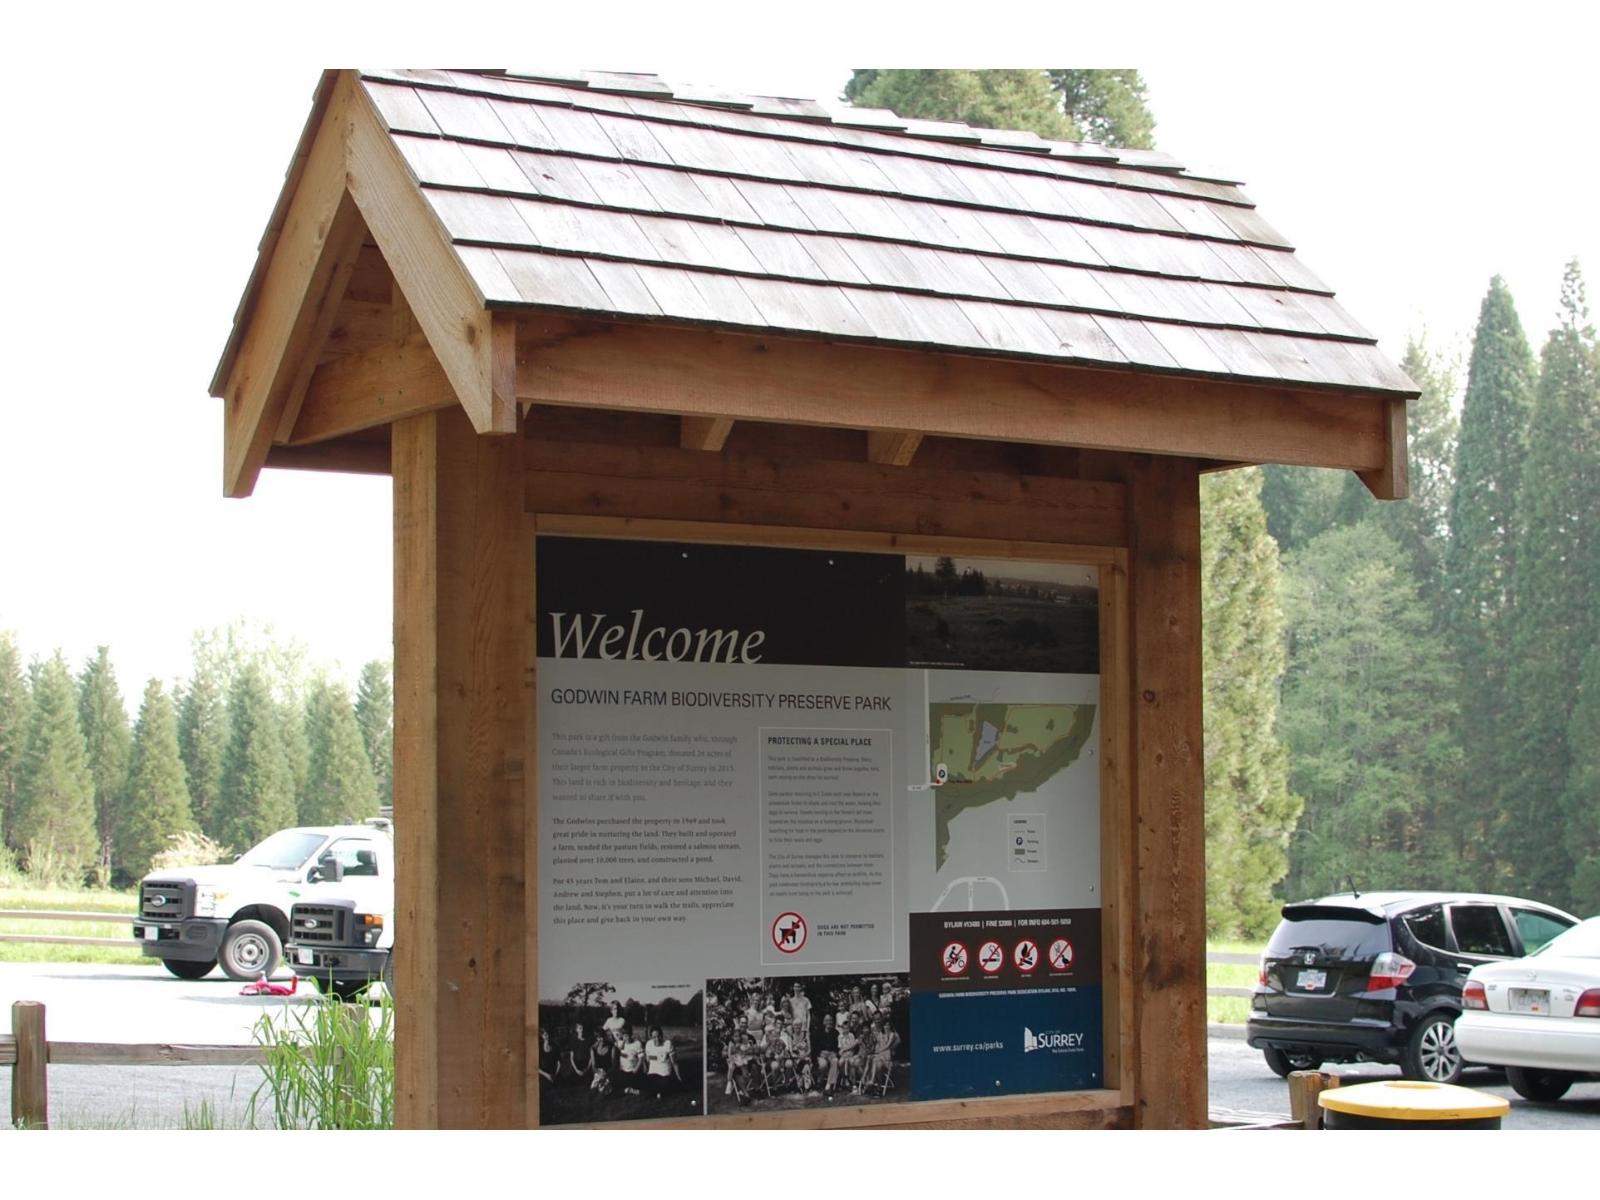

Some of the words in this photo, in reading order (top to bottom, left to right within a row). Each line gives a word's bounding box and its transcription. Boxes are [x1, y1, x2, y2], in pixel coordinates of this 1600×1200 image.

[549, 609, 765, 664] Welcome
[551, 688, 619, 705] GODWIN
[623, 690, 667, 706] FARM
[671, 691, 775, 708] BIODIVERSITY
[778, 694, 852, 710] PRESERVE
[855, 696, 891, 711] PARK
[768, 737, 811, 745] PROTECTING
[820, 738, 850, 746] SPECIAL
[850, 738, 873, 747] PLACE
[1018, 919, 1028, 927] FOR
[933, 1040, 1004, 1053] www.surrey.ca/parks
[1038, 1033, 1084, 1048] SURREY
